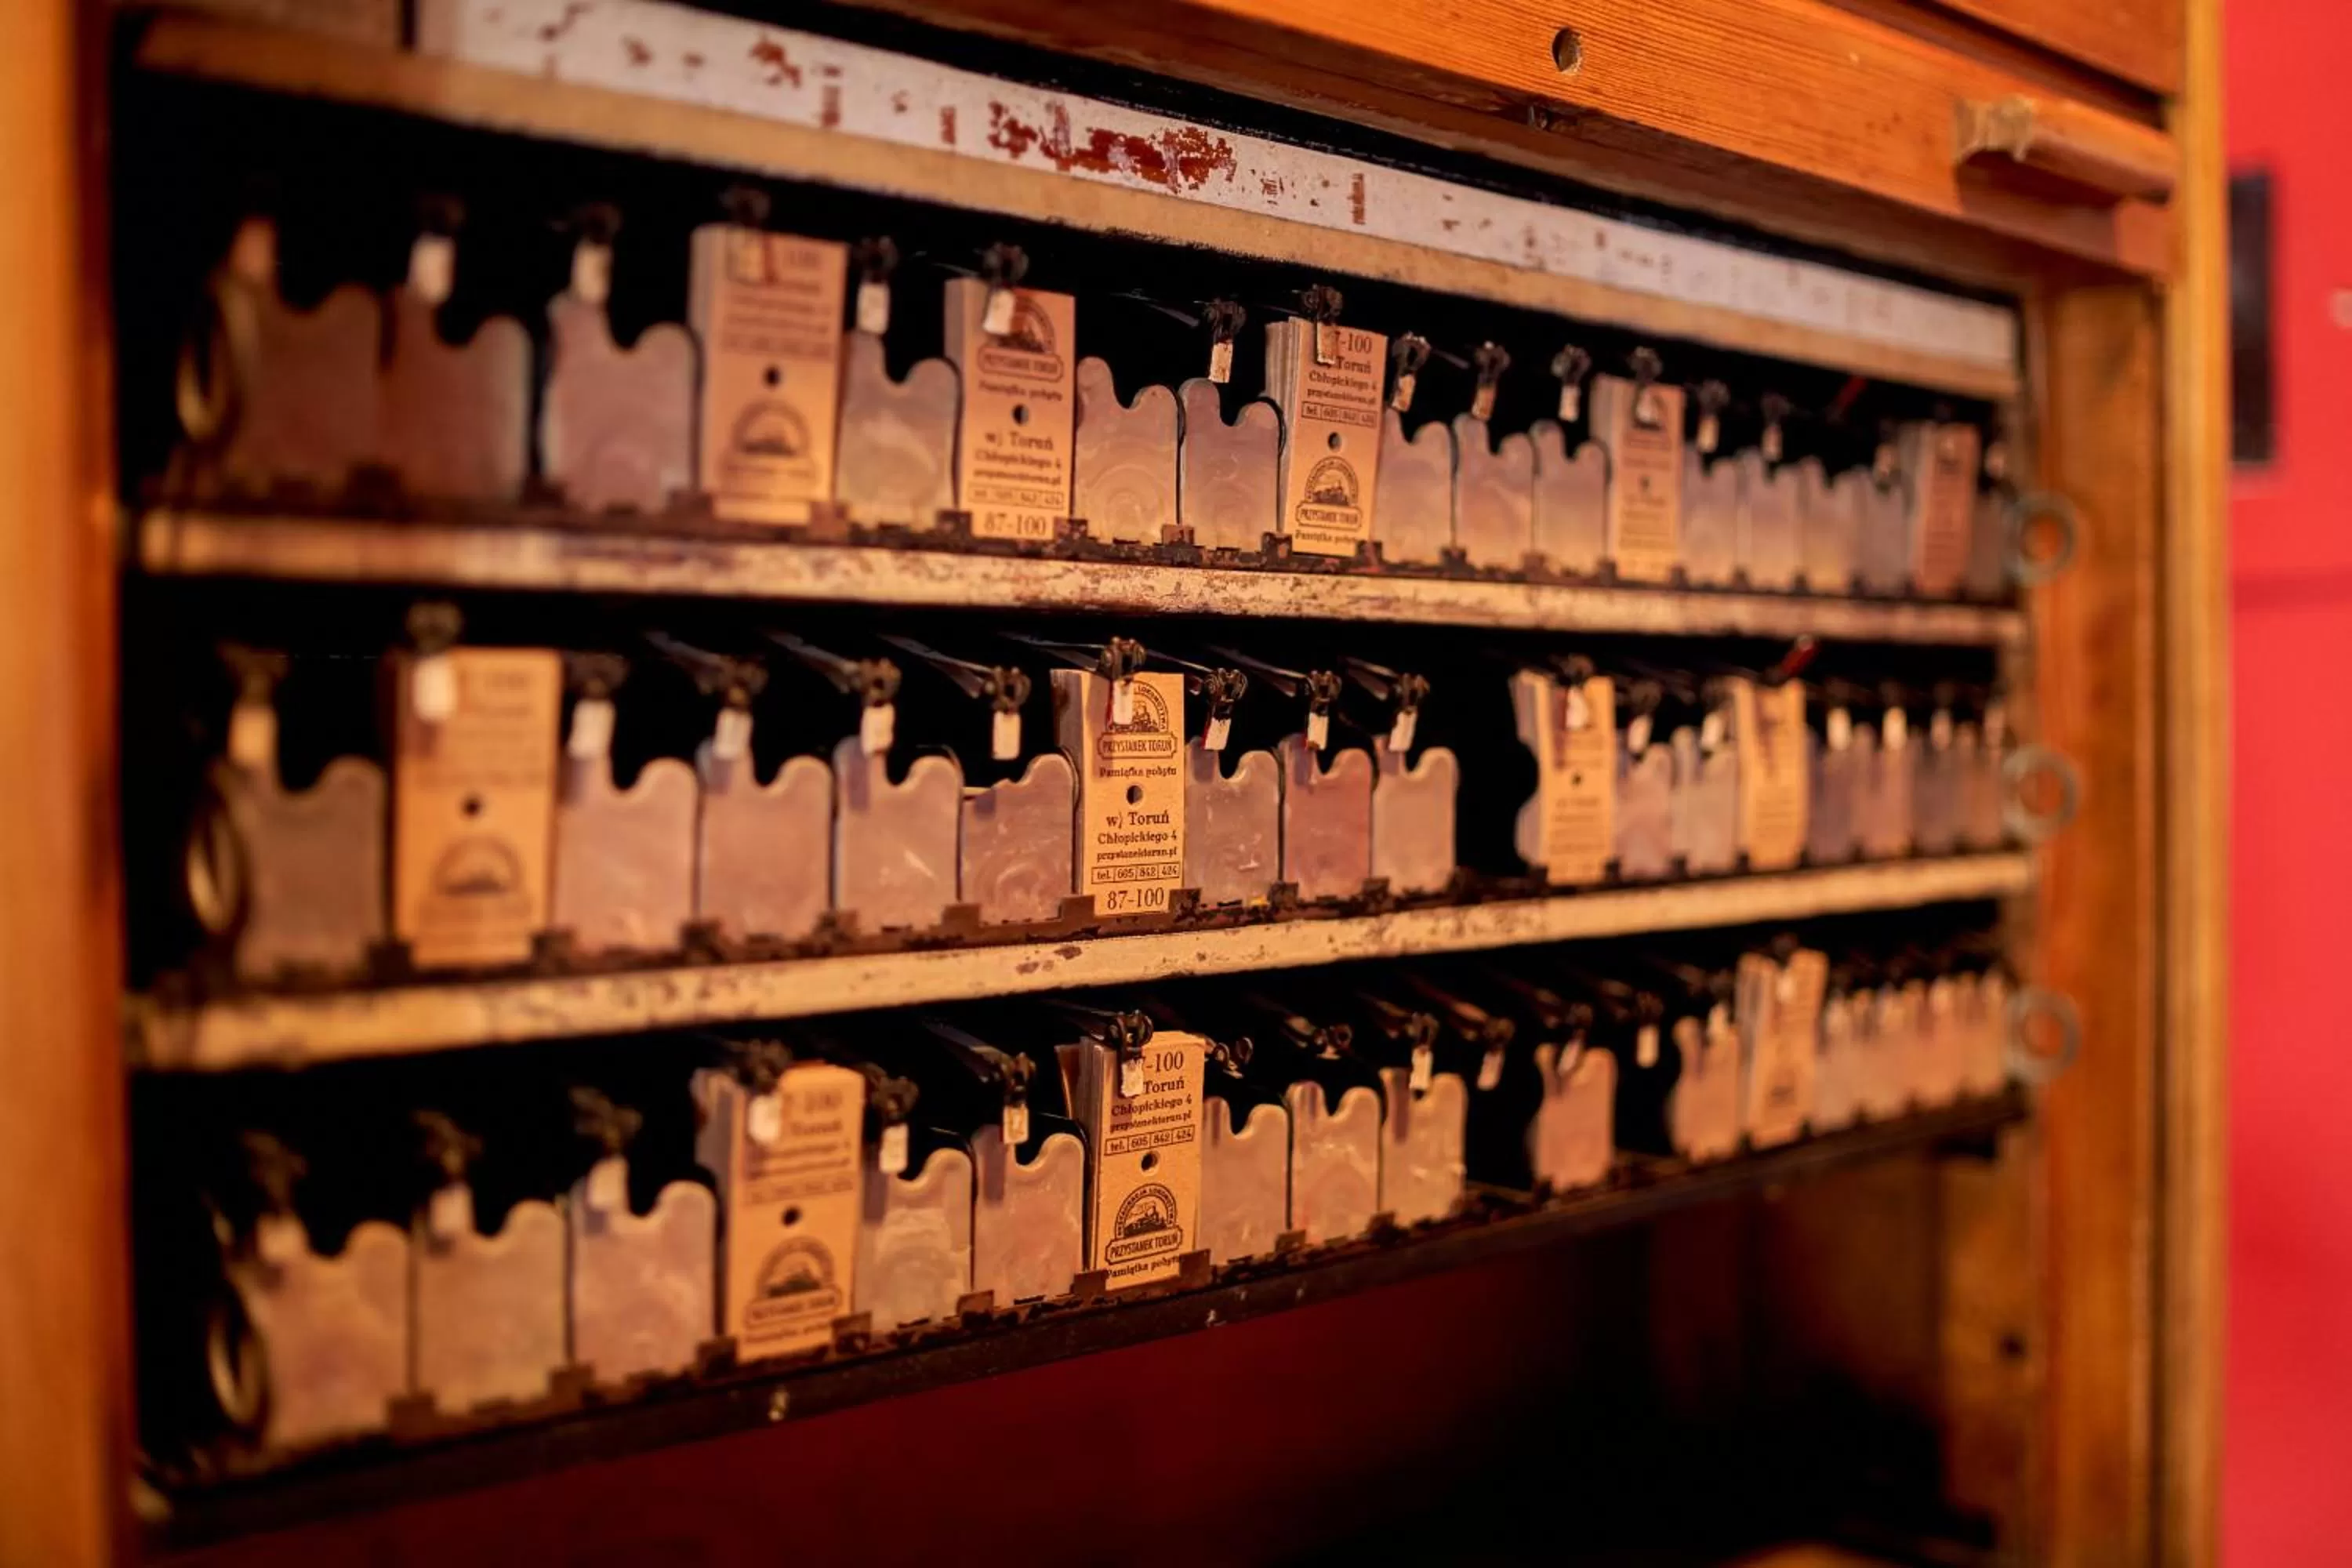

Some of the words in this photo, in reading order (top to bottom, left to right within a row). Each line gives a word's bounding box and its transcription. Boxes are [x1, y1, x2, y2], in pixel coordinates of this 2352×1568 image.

[1334, 329, 1373, 354] 7-100
[984, 511, 1047, 536] 87-100
[1103, 739, 1147, 753] PRZYSTANEK
[1127, 809, 1170, 826] Toruń
[1098, 830, 1168, 846] Chłopickiego
[1139, 866, 1156, 877] 842
[1106, 887, 1165, 911] 87-100
[1143, 1075, 1185, 1094] Toruń
[1111, 1098, 1183, 1117] Chłopickiego
[1111, 1238, 1153, 1258] PRZYSTANEK
